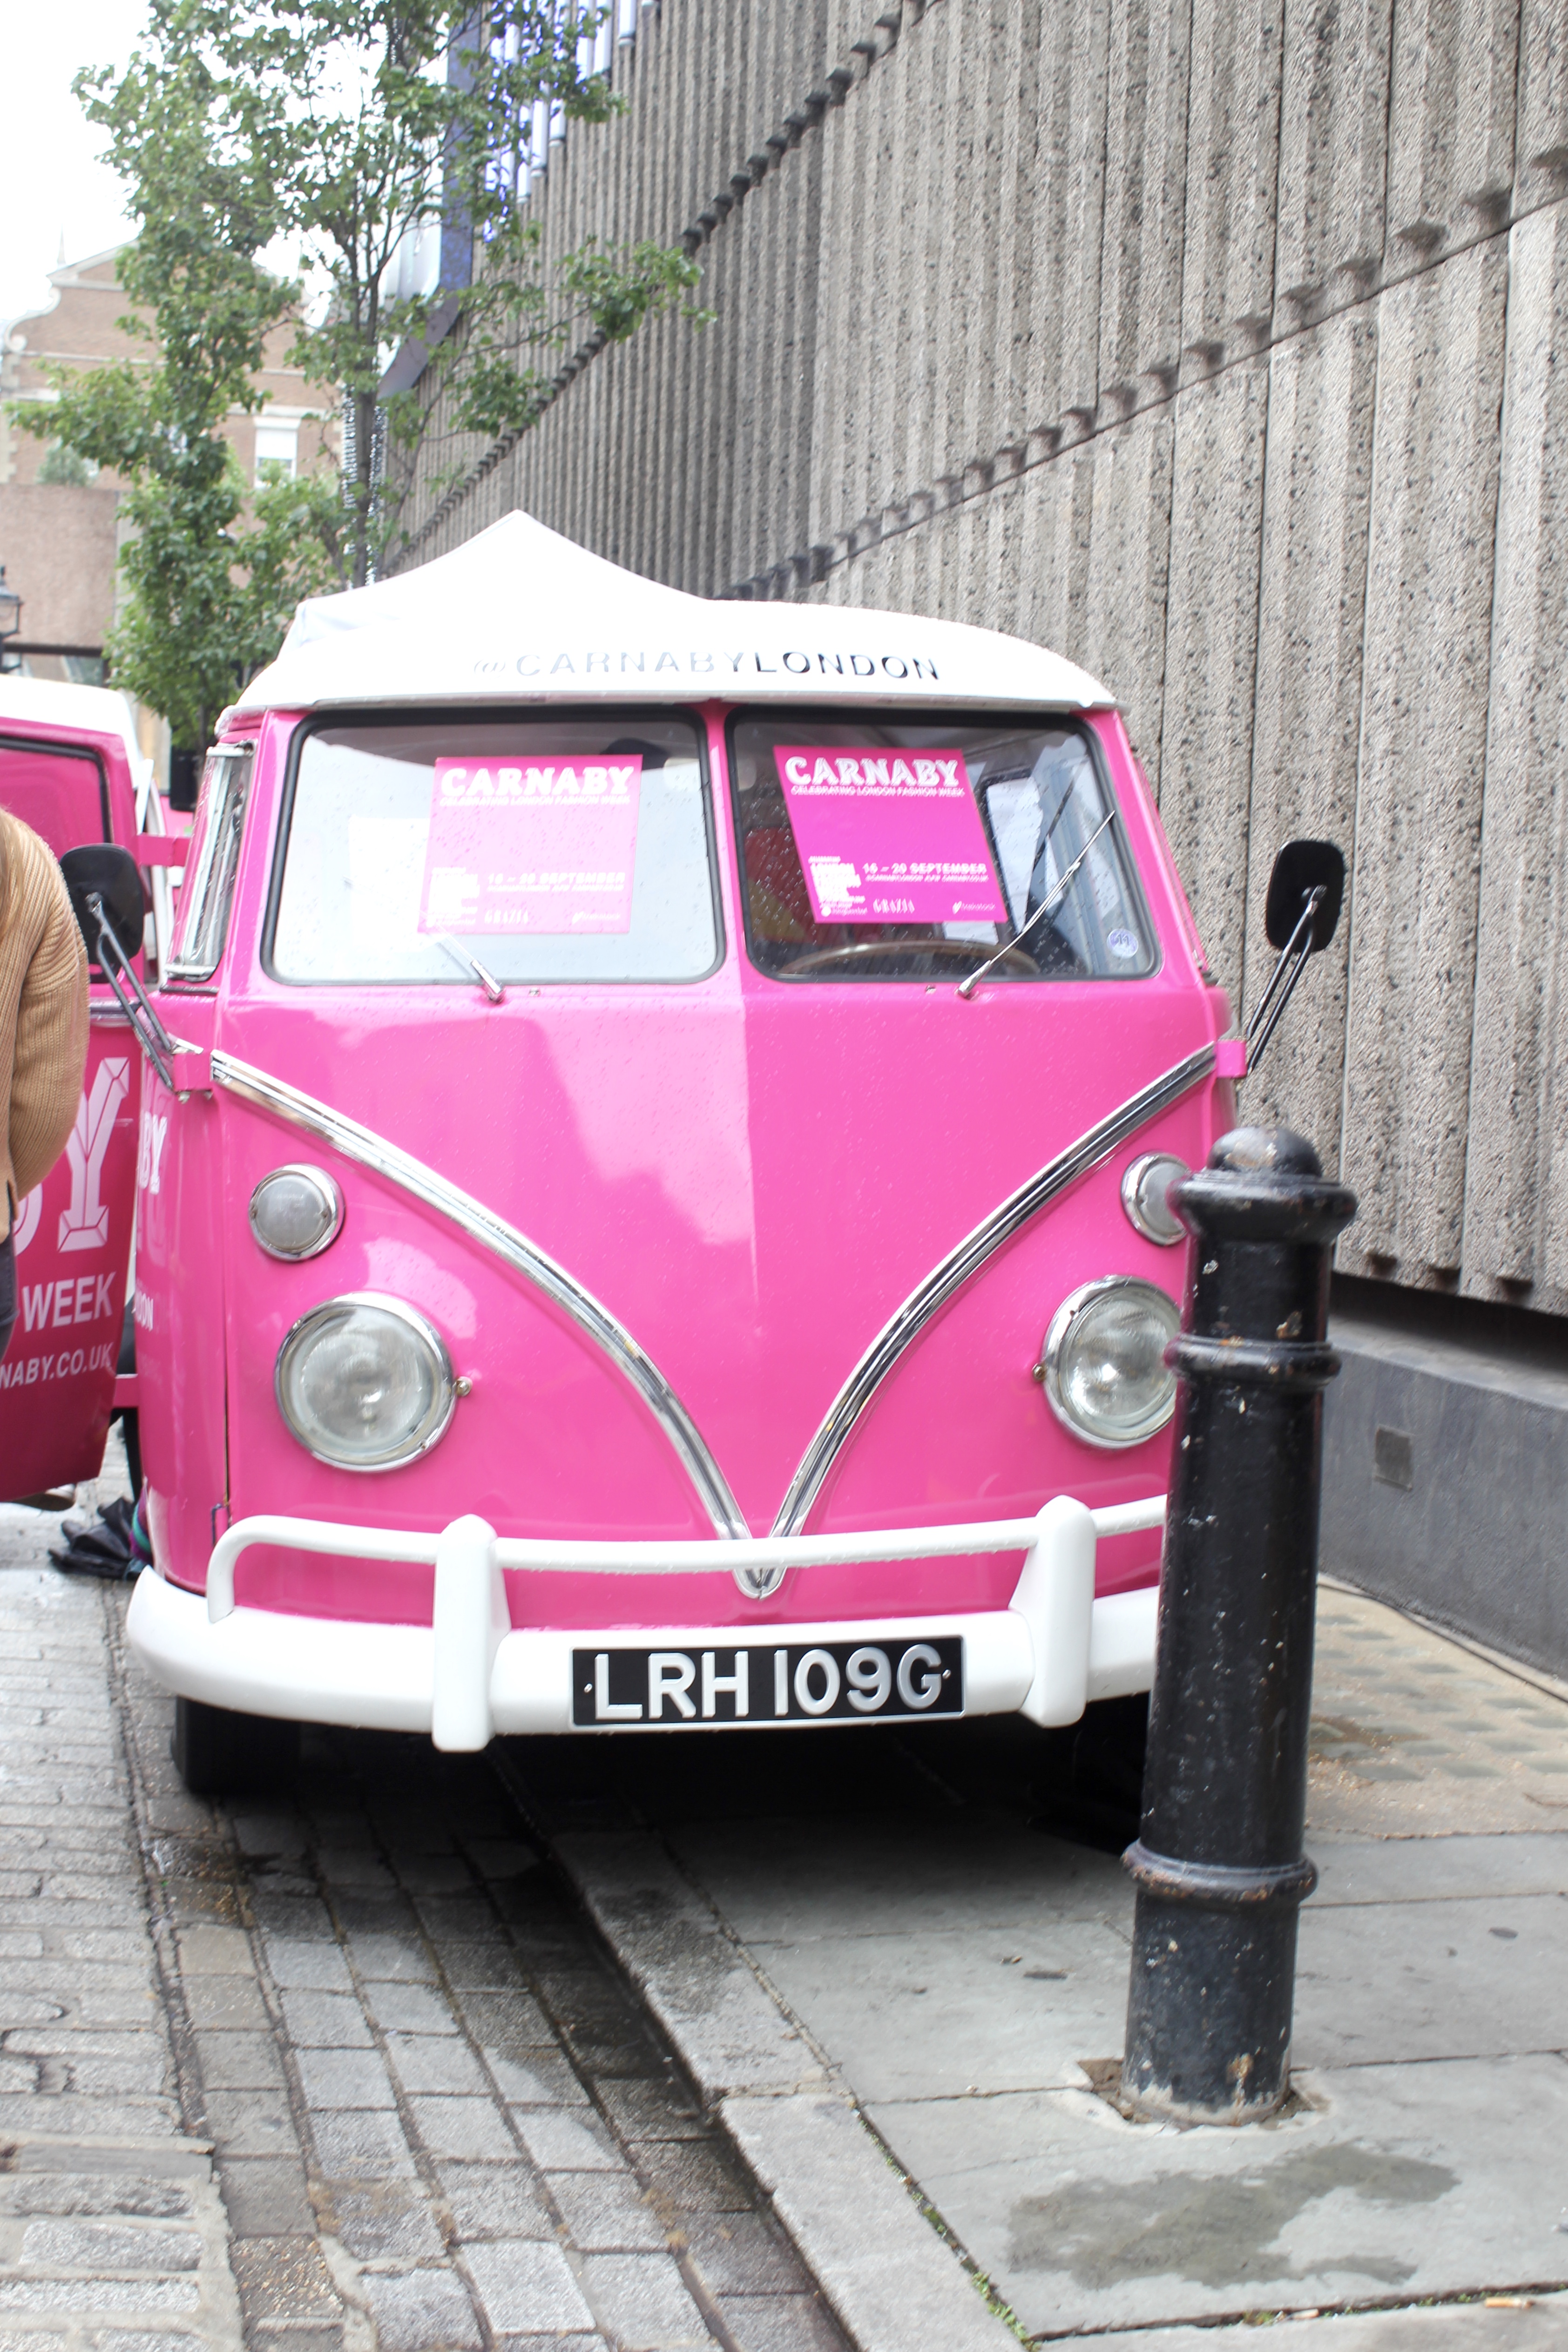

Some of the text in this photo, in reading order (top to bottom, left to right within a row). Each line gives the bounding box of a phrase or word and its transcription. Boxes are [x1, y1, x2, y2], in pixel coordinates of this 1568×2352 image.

[473, 651, 939, 680] @CARNABYLONDON
[441, 766, 635, 796] CARNABY
[784, 756, 960, 787] CARNABY
[510, 795, 553, 806] LONDON
[554, 794, 600, 806] FASHION
[601, 794, 631, 805] WEEK
[791, 785, 965, 798] CELEBRATING LONDON FASHION WEEK
[539, 872, 626, 884] SEPTEMBER
[891, 862, 907, 874] 20
[909, 862, 987, 875] SEPTEMBER
[22, 1271, 116, 1333] WEEK
[0, 1342, 116, 1390] NABY.CO.UK
[595, 1643, 942, 1720] LRH 109G
